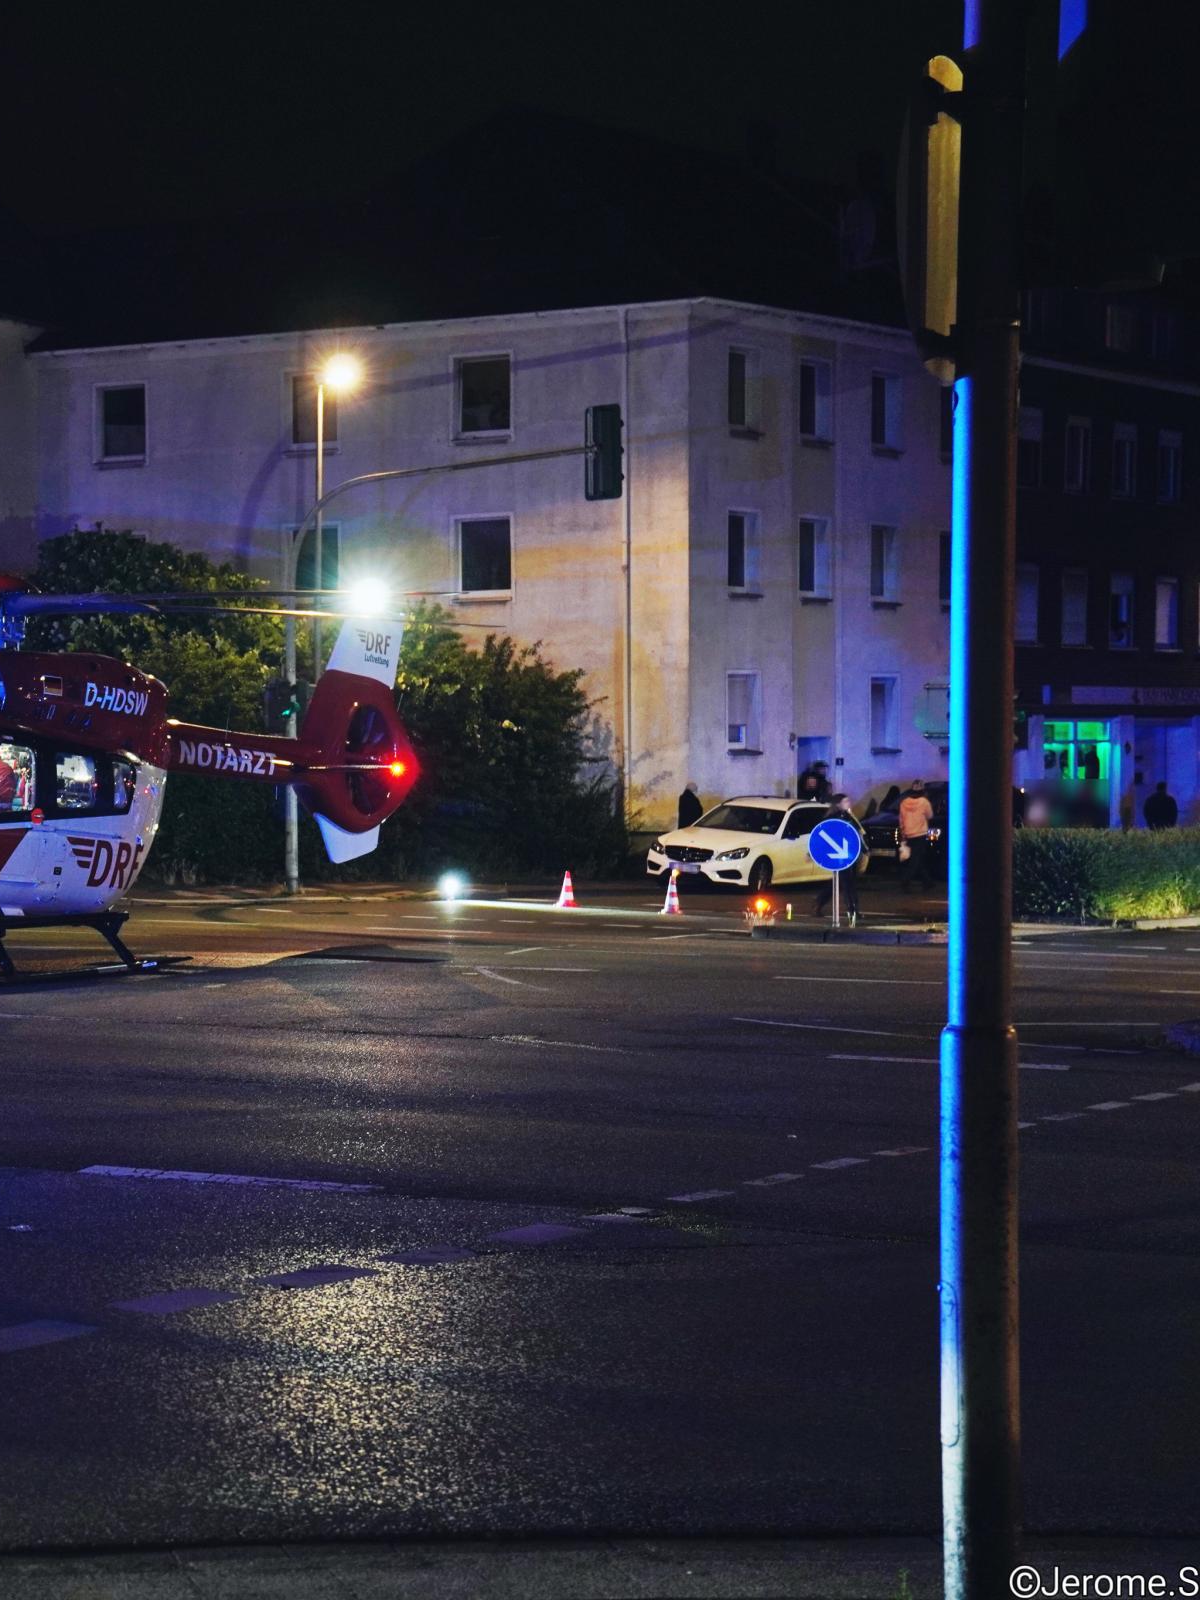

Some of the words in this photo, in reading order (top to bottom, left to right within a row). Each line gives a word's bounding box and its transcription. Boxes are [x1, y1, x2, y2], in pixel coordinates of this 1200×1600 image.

[366, 632, 392, 655] DRF
[84, 682, 149, 717] D-HDSW
[178, 740, 278, 776] NOTARZT
[86, 840, 144, 889] DRF
